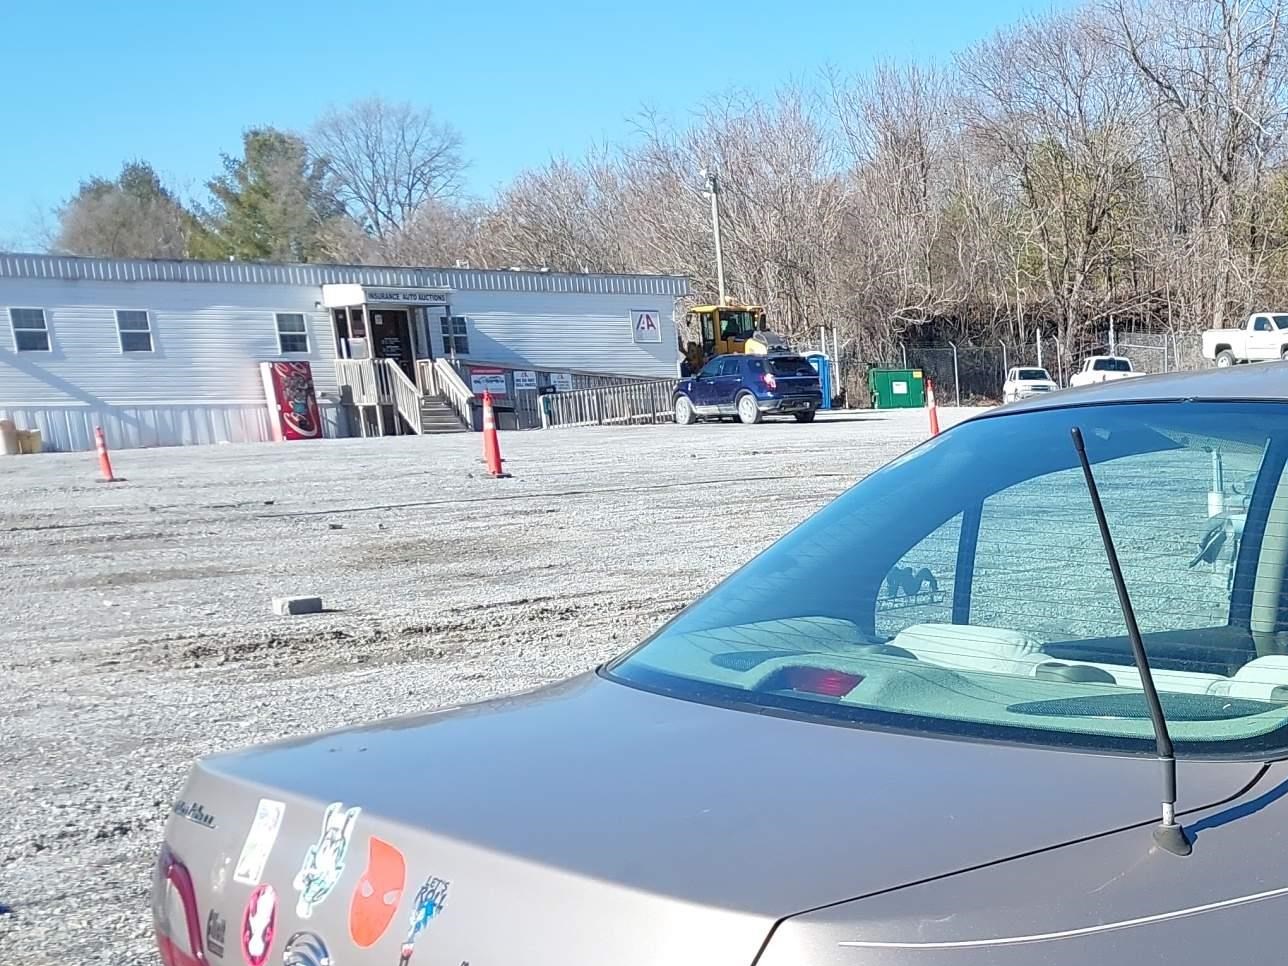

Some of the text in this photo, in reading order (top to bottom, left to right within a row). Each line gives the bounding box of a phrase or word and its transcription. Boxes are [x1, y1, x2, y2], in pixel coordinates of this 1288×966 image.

[367, 292, 446, 302] INSURANCE AUTO AUCTIONS
